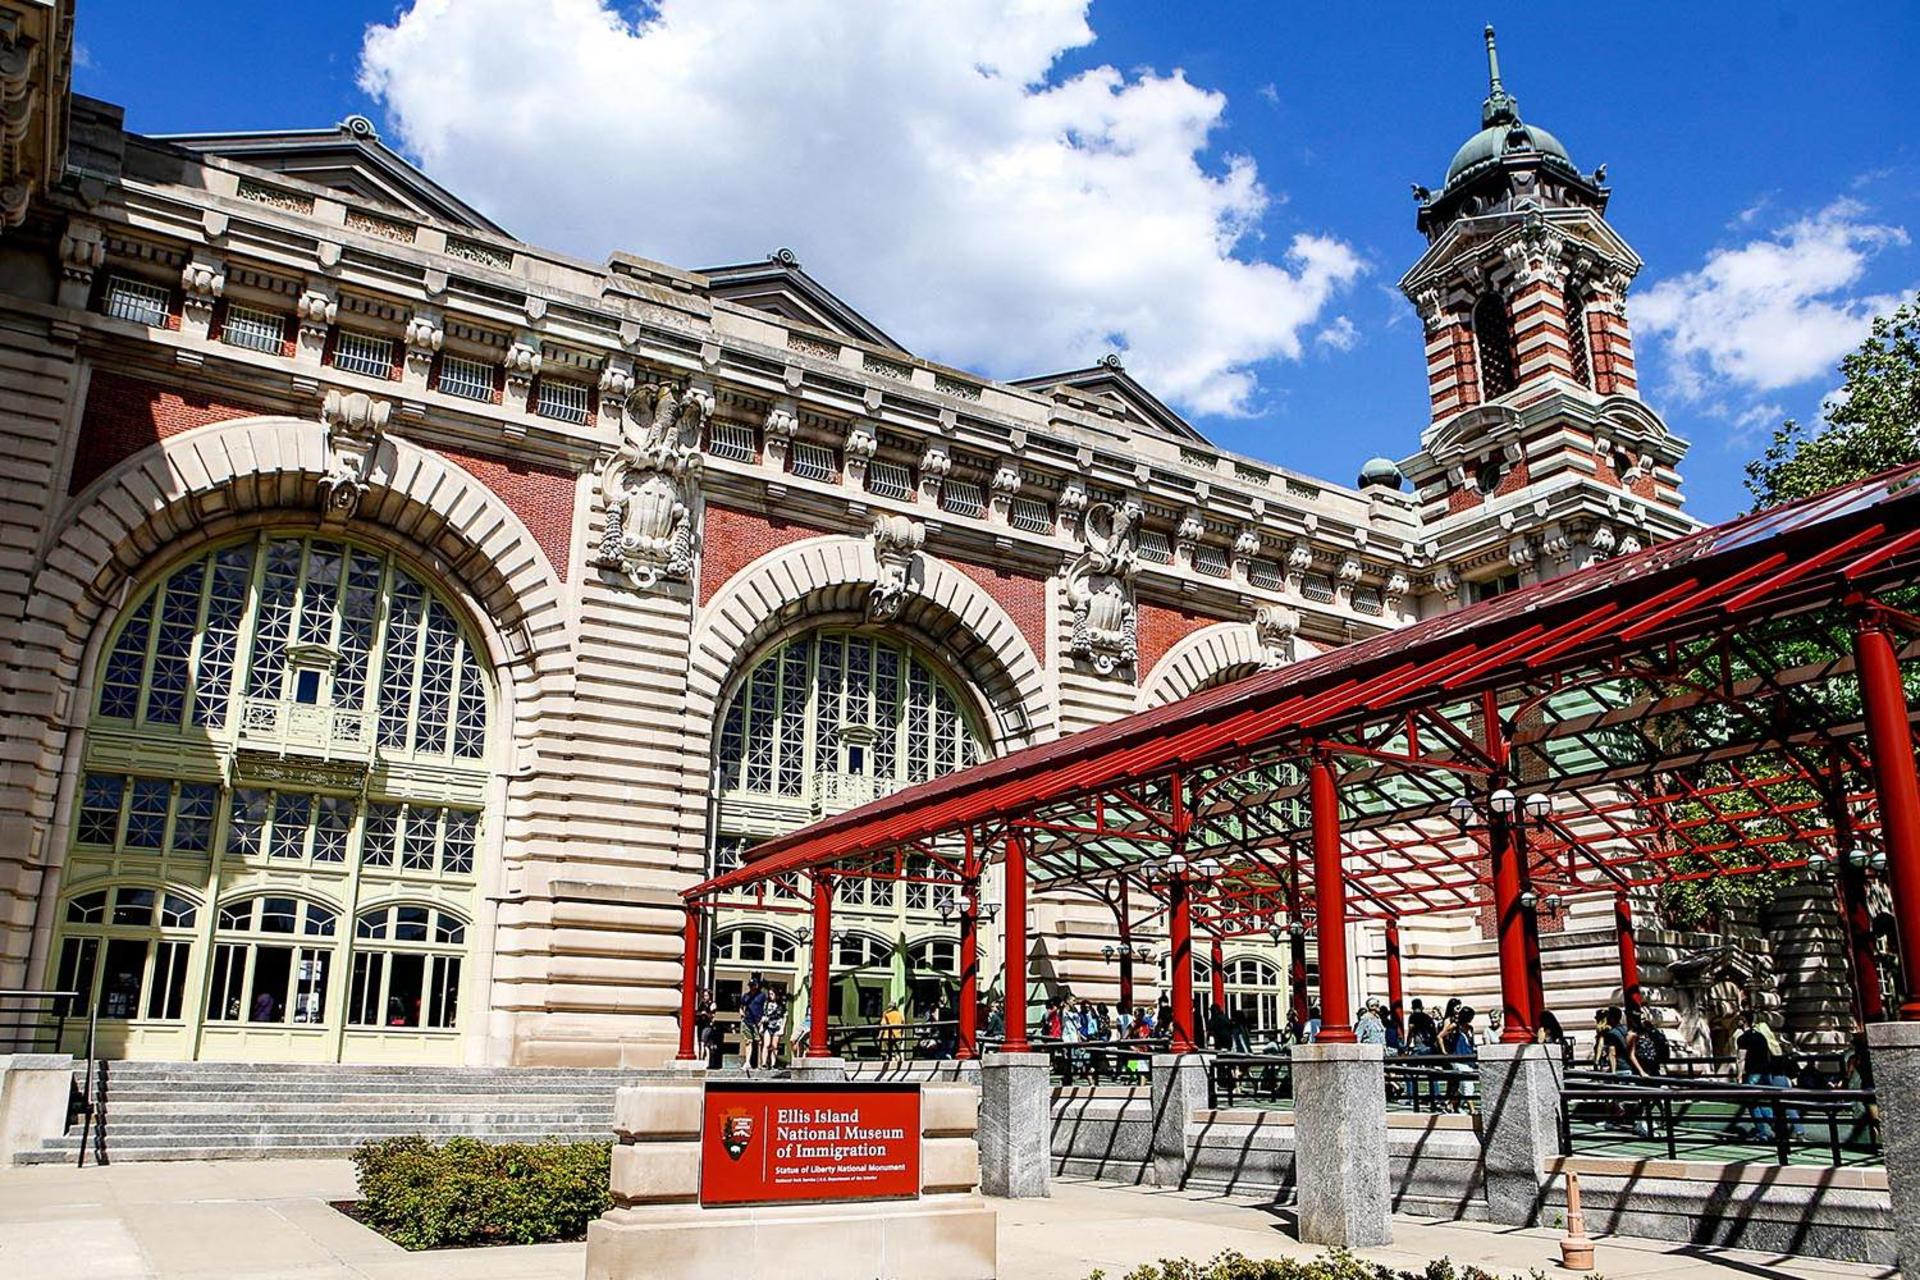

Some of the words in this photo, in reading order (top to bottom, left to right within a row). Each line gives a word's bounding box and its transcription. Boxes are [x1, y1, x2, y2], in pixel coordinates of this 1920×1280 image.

[777, 1109, 811, 1124] Ellis
[814, 1109, 859, 1124] Island
[776, 1126, 841, 1141] National
[844, 1126, 905, 1140] Museum
[776, 1143, 793, 1158] of
[795, 1143, 887, 1161] Immigration
[775, 1166, 800, 1175] Statue
[801, 1164, 810, 1174] of
[810, 1164, 836, 1175] Liberty
[837, 1163, 867, 1173] National
[868, 1163, 906, 1172] Monument
